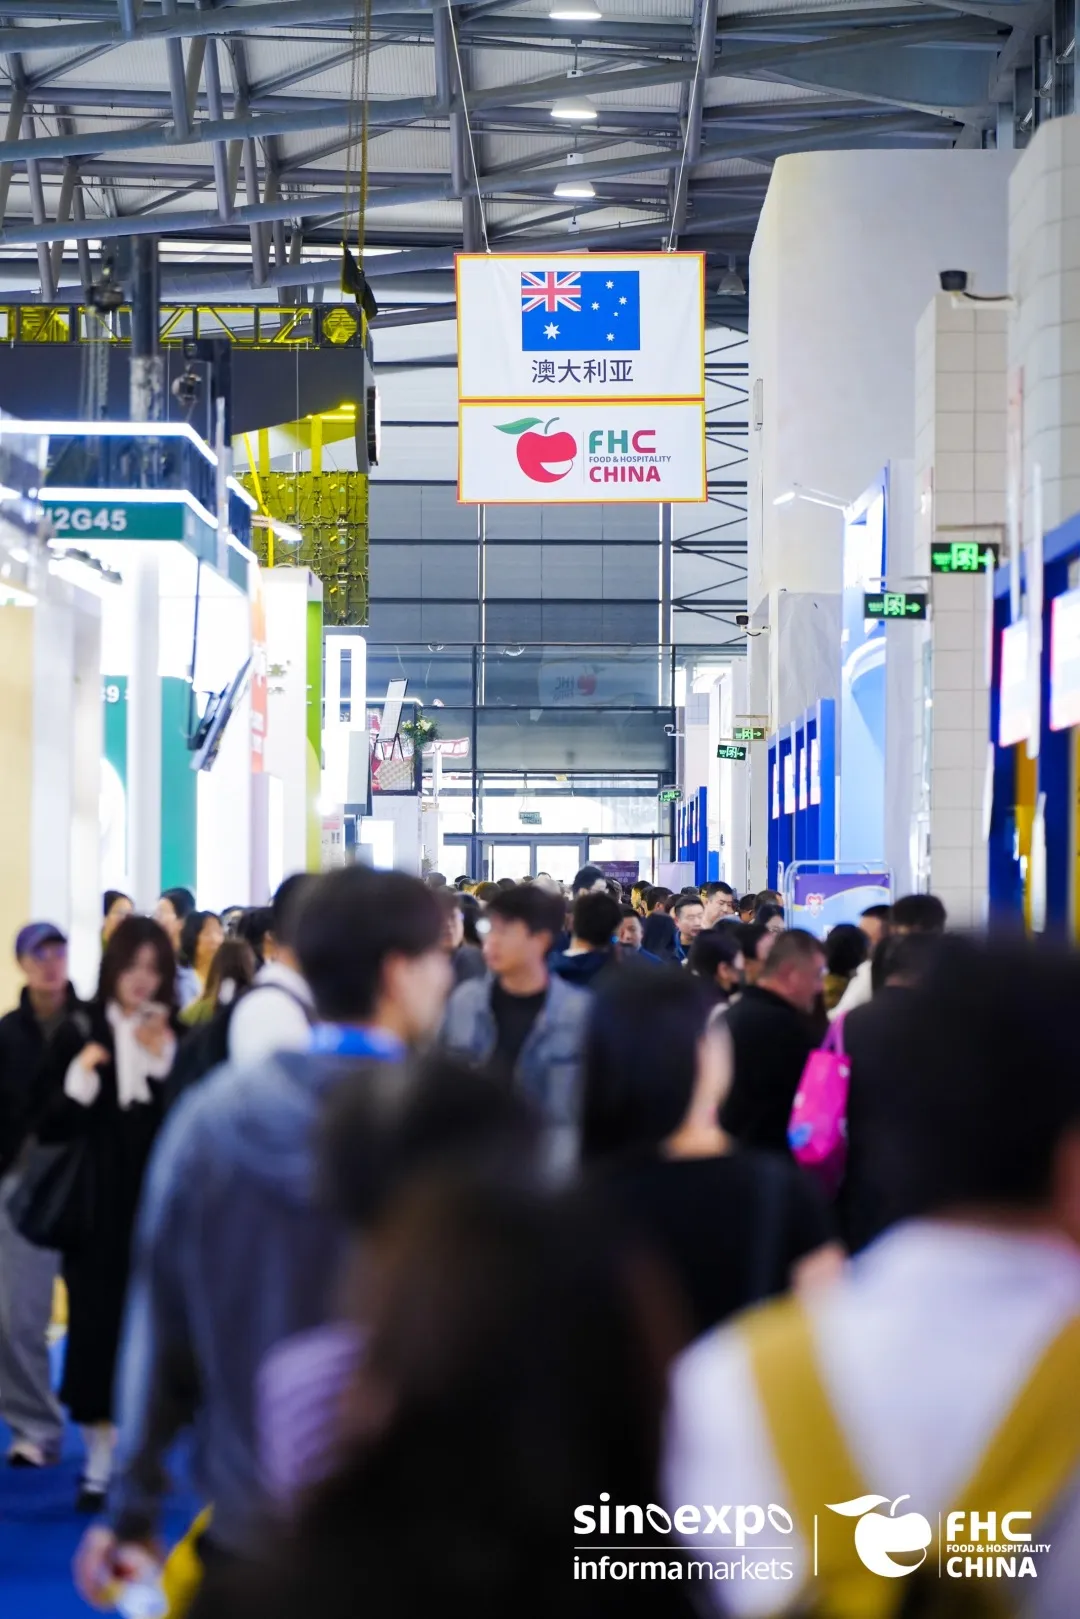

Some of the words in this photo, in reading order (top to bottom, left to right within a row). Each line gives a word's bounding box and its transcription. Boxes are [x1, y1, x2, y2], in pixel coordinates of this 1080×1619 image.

[532, 358, 633, 383] 澳大利亚
[589, 430, 656, 454] FHC
[620, 455, 671, 463] HOSPITALITY
[589, 466, 661, 483] CHINA
